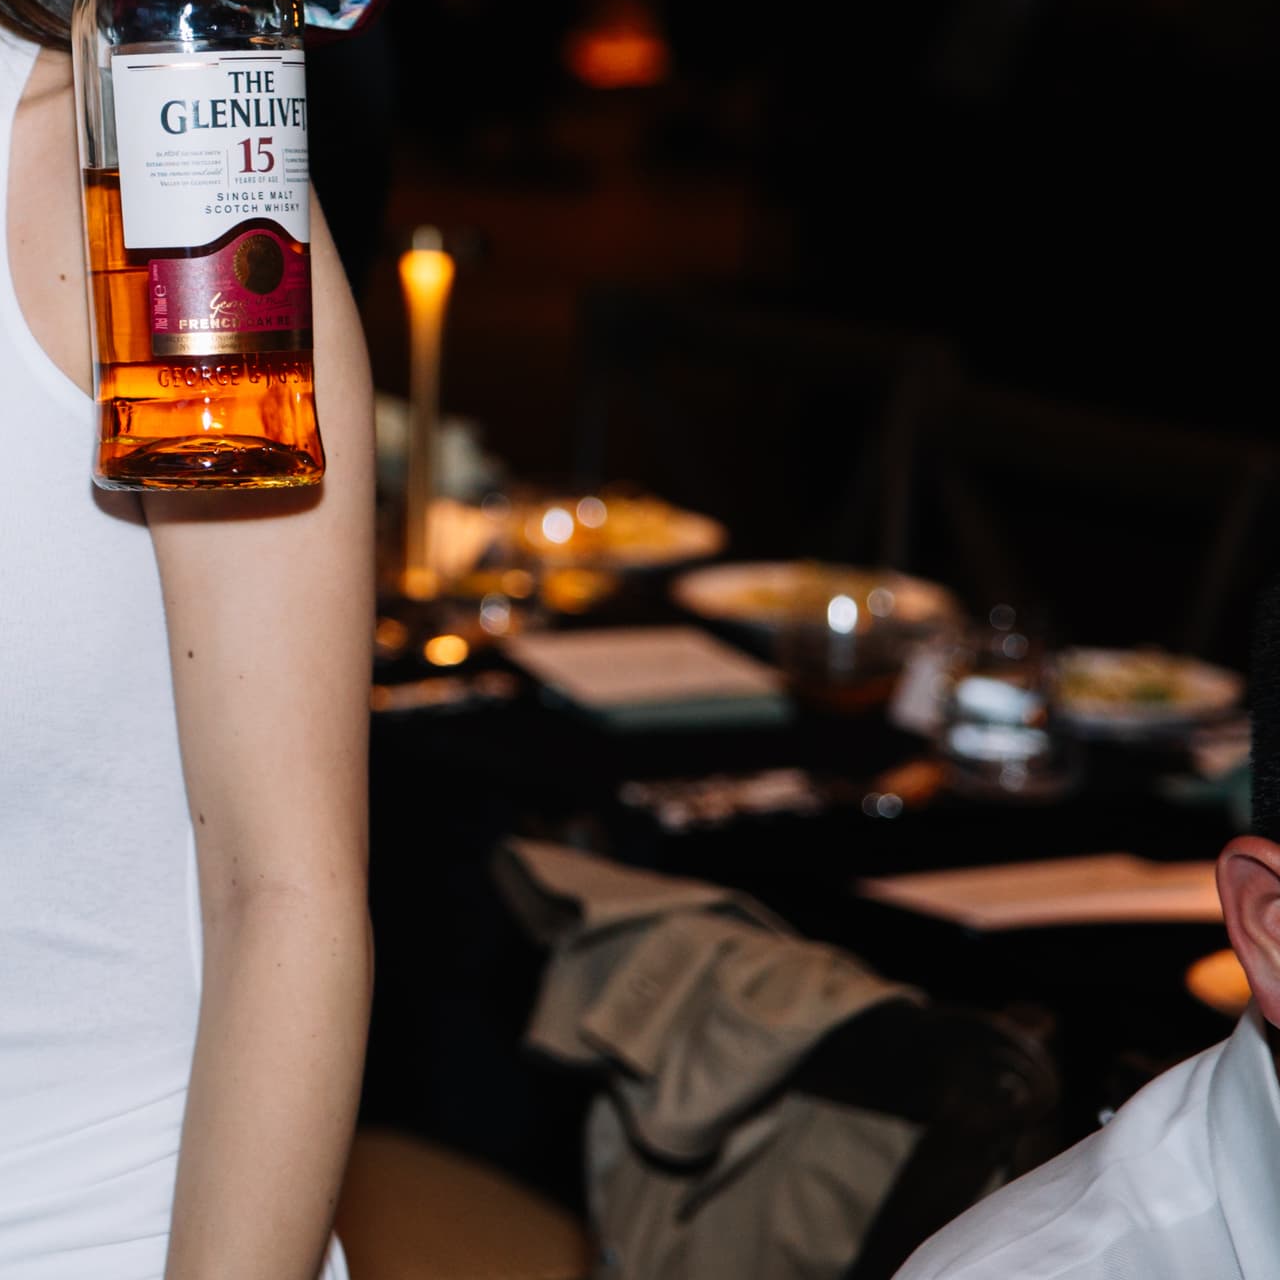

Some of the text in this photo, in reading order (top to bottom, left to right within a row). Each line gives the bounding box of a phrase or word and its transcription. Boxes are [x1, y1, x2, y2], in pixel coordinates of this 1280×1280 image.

[228, 71, 275, 93] THE
[237, 136, 275, 174] 15
[235, 176, 256, 184] YEARS
[268, 175, 279, 183] AGE
[217, 190, 293, 202] SINGLE MALT
[205, 203, 300, 214] SCOTCH WHISKY
[179, 318, 239, 330] FRENCH
[158, 365, 240, 387] GEORGE
